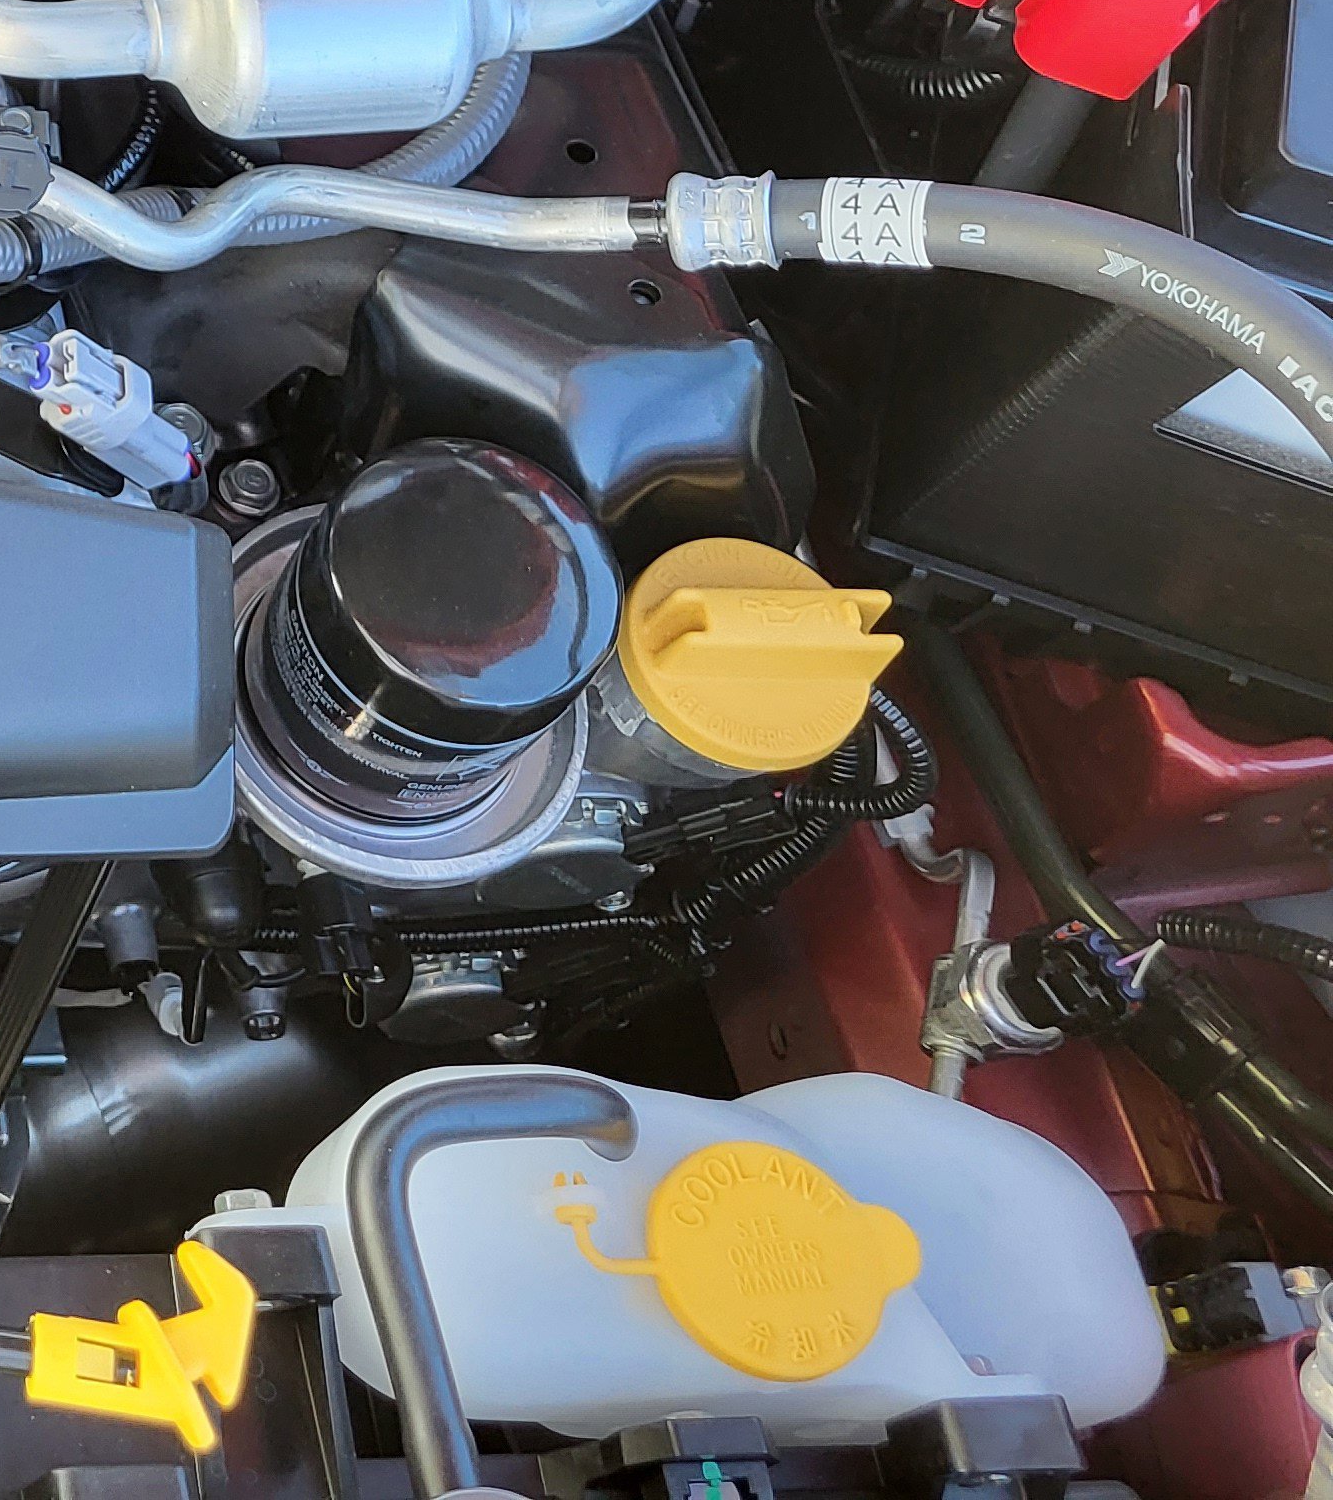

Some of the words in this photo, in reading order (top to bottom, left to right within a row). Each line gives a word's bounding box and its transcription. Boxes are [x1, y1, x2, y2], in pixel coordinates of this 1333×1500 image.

[959, 222, 986, 245] 2
[1140, 263, 1267, 355] YOKOHAMA
[290, 609, 325, 682] CAUTION
[371, 730, 423, 758] TIGHTEN
[671, 1152, 848, 1229] COOLANT
[735, 1215, 780, 1240] SEE
[727, 1240, 822, 1268] OWNERS
[735, 1266, 827, 1296] MANUAL
[744, 1310, 856, 1363] 冷却水
